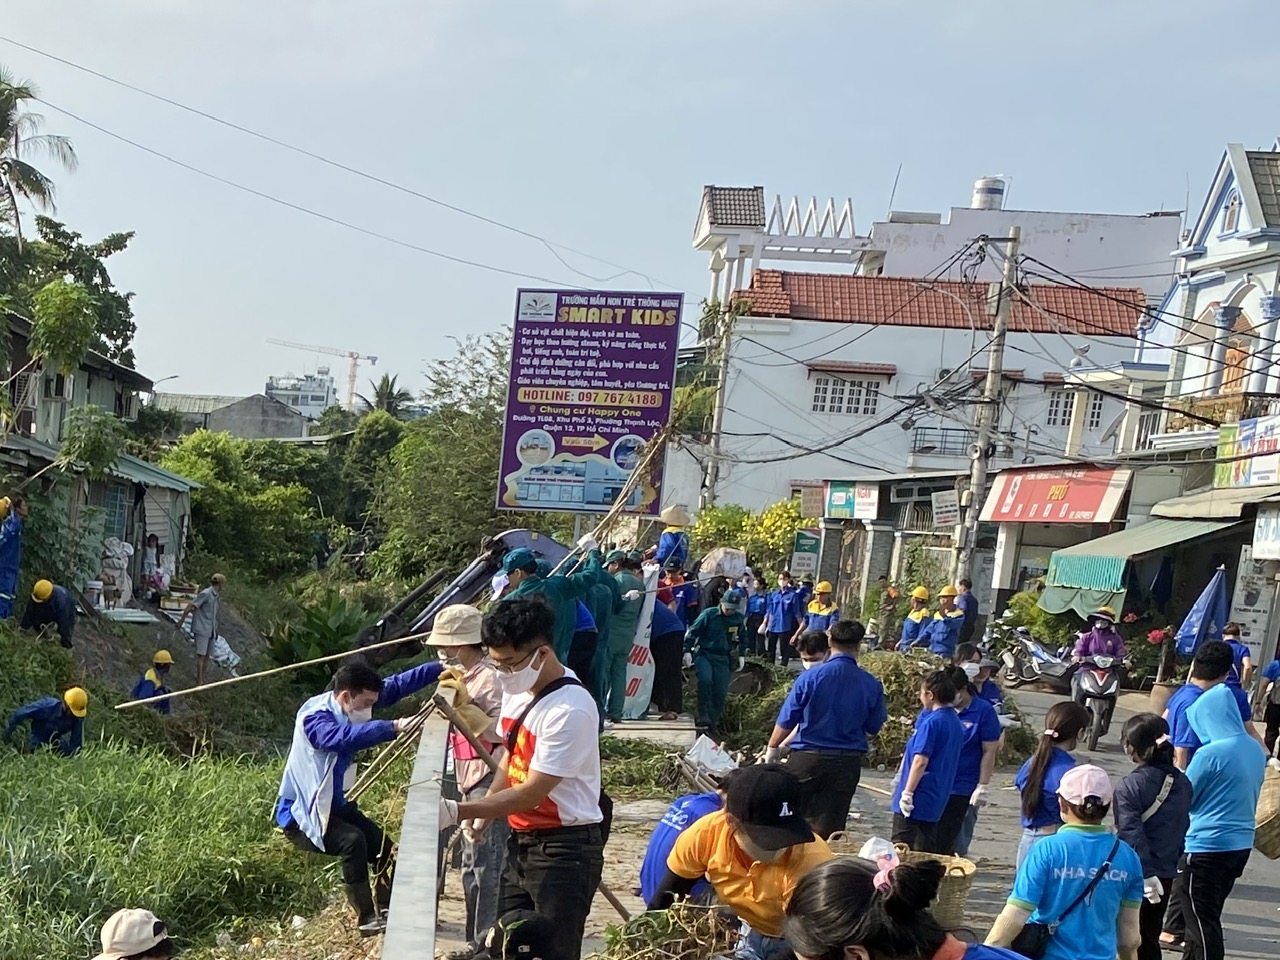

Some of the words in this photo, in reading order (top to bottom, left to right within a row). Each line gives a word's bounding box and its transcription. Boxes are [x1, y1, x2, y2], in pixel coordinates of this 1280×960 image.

[561, 294, 588, 305] TRƯỜNG
[607, 297, 621, 306] NON
[623, 296, 636, 307] TRẺ
[661, 299, 679, 308] MINH
[558, 306, 626, 324] SMART
[631, 308, 677, 326] KIDS
[523, 390, 574, 402] HOTLINE:
[578, 391, 599, 403] 097
[604, 392, 625, 404] 767
[627, 393, 657, 405] 4188
[539, 405, 571, 416] Chung
[573, 407, 586, 415] cư
[587, 407, 620, 417] Happy
[621, 408, 642, 417] One
[543, 424, 563, 432] Quận
[586, 425, 597, 433] Hồ
[571, 416, 587, 424] Phố
[595, 417, 623, 426] Phường
[624, 418, 646, 428] Thạnh
[1047, 480, 1070, 501] PHÚ
[1053, 866, 1085, 880] NHÀ
